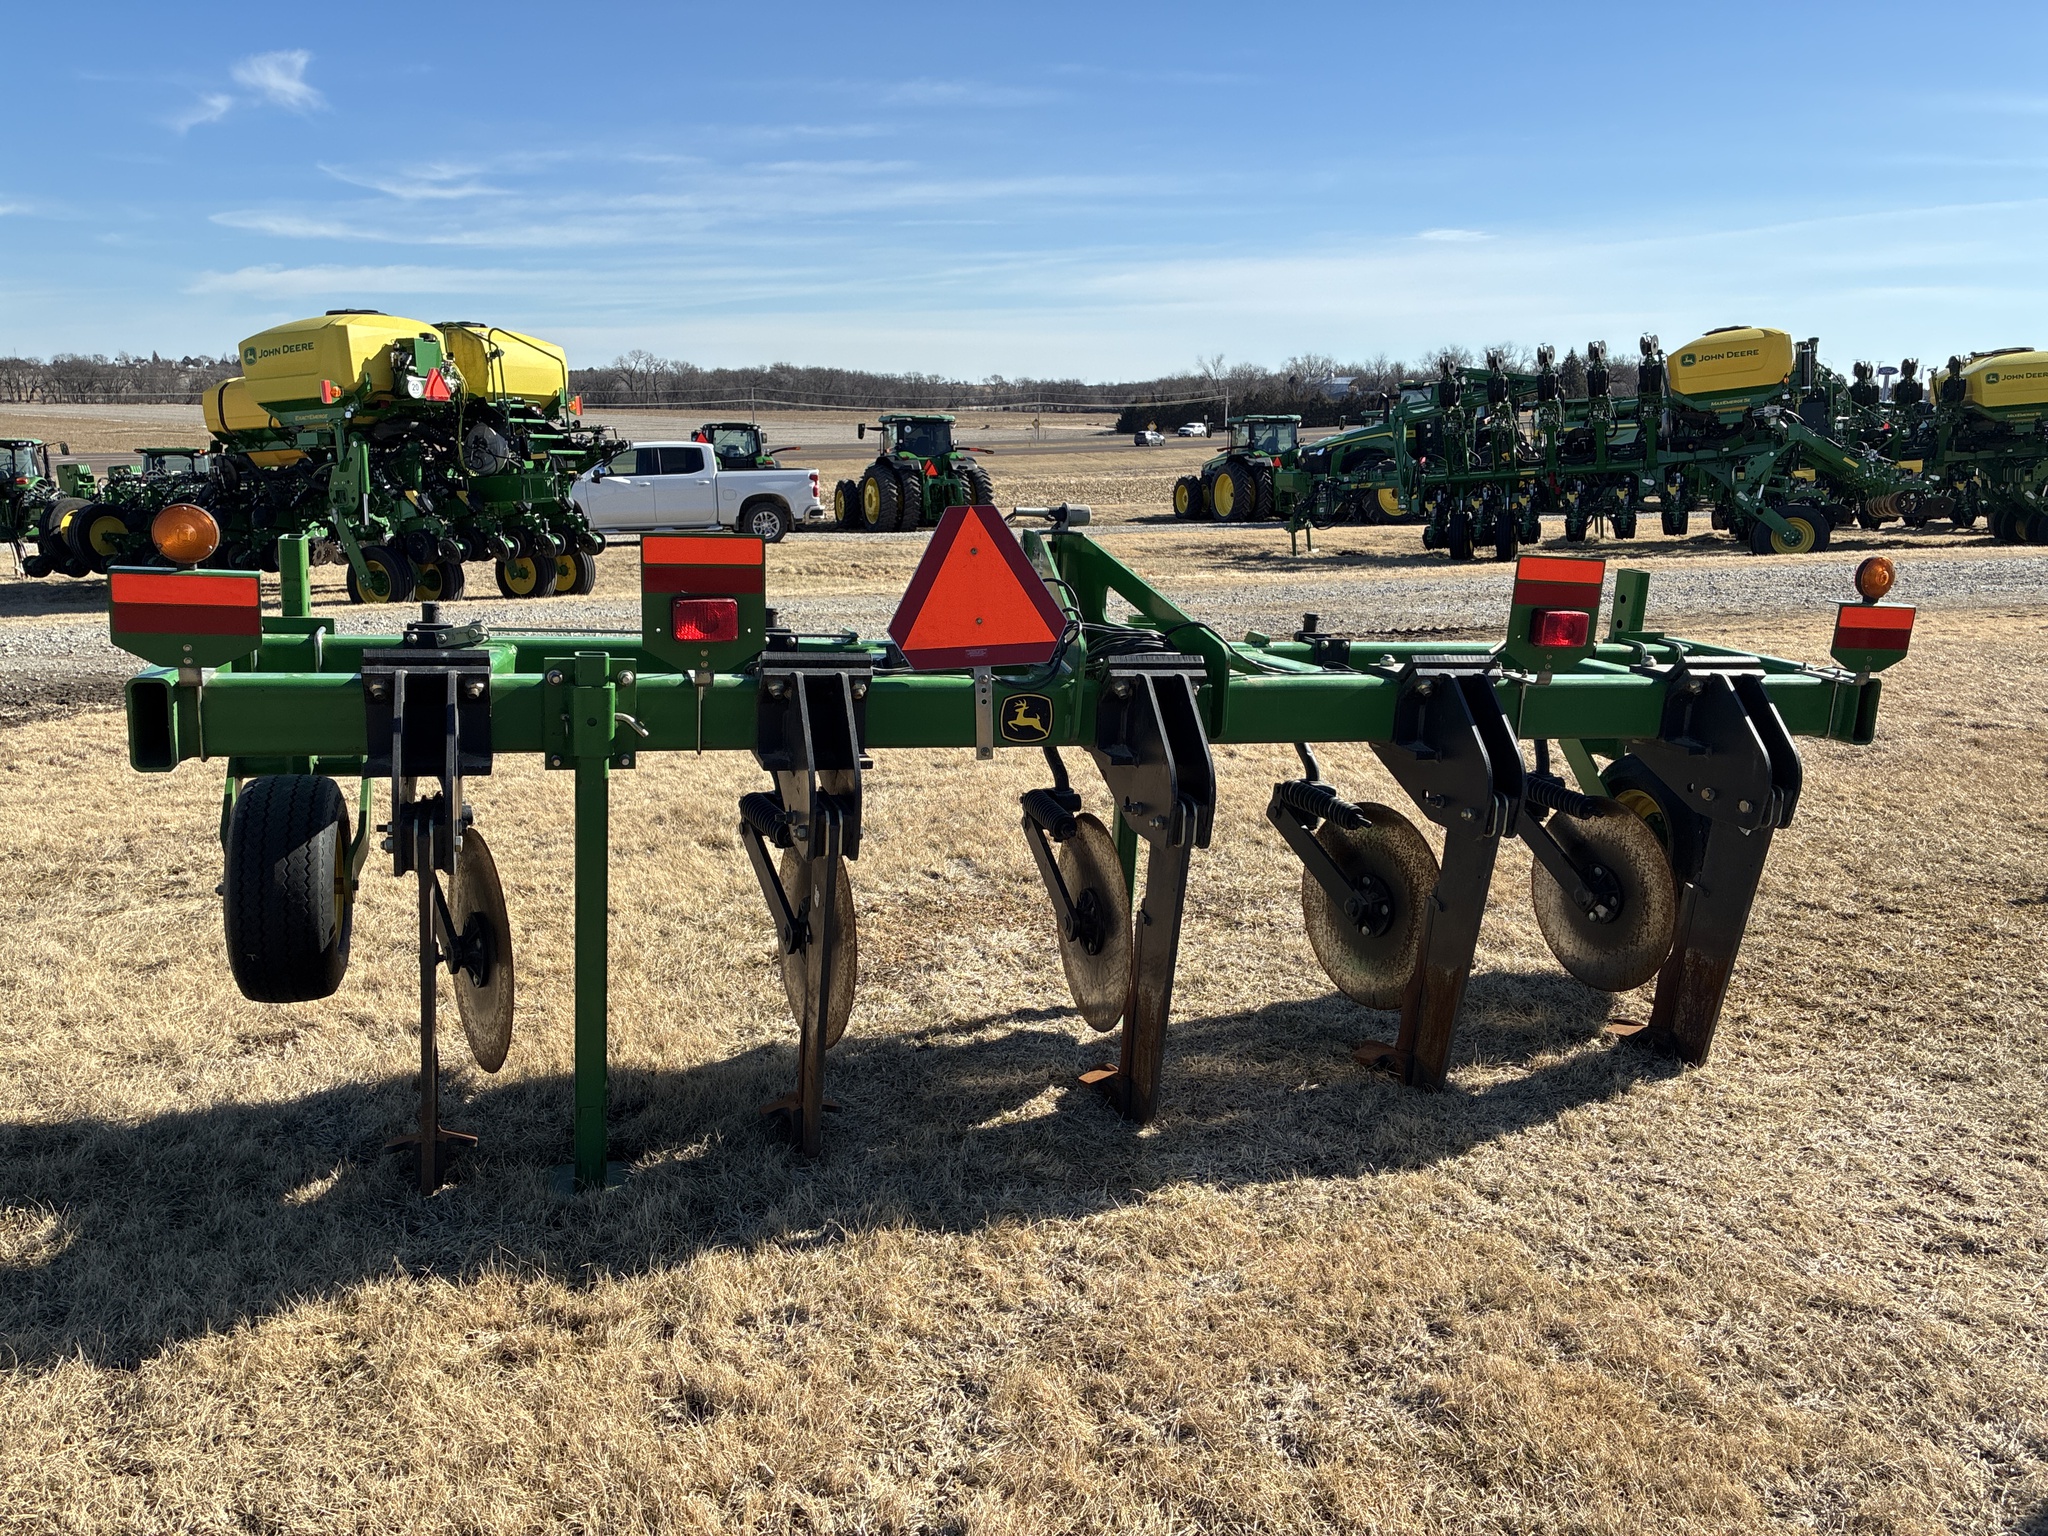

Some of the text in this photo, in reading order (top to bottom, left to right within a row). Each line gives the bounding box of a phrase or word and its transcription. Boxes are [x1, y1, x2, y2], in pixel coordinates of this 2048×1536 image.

[259, 342, 314, 359] JOHN DEERE
[1699, 349, 1759, 362] JOHN DEERE
[2001, 373, 2024, 381] JOHN
[412, 383, 419, 391] 20
